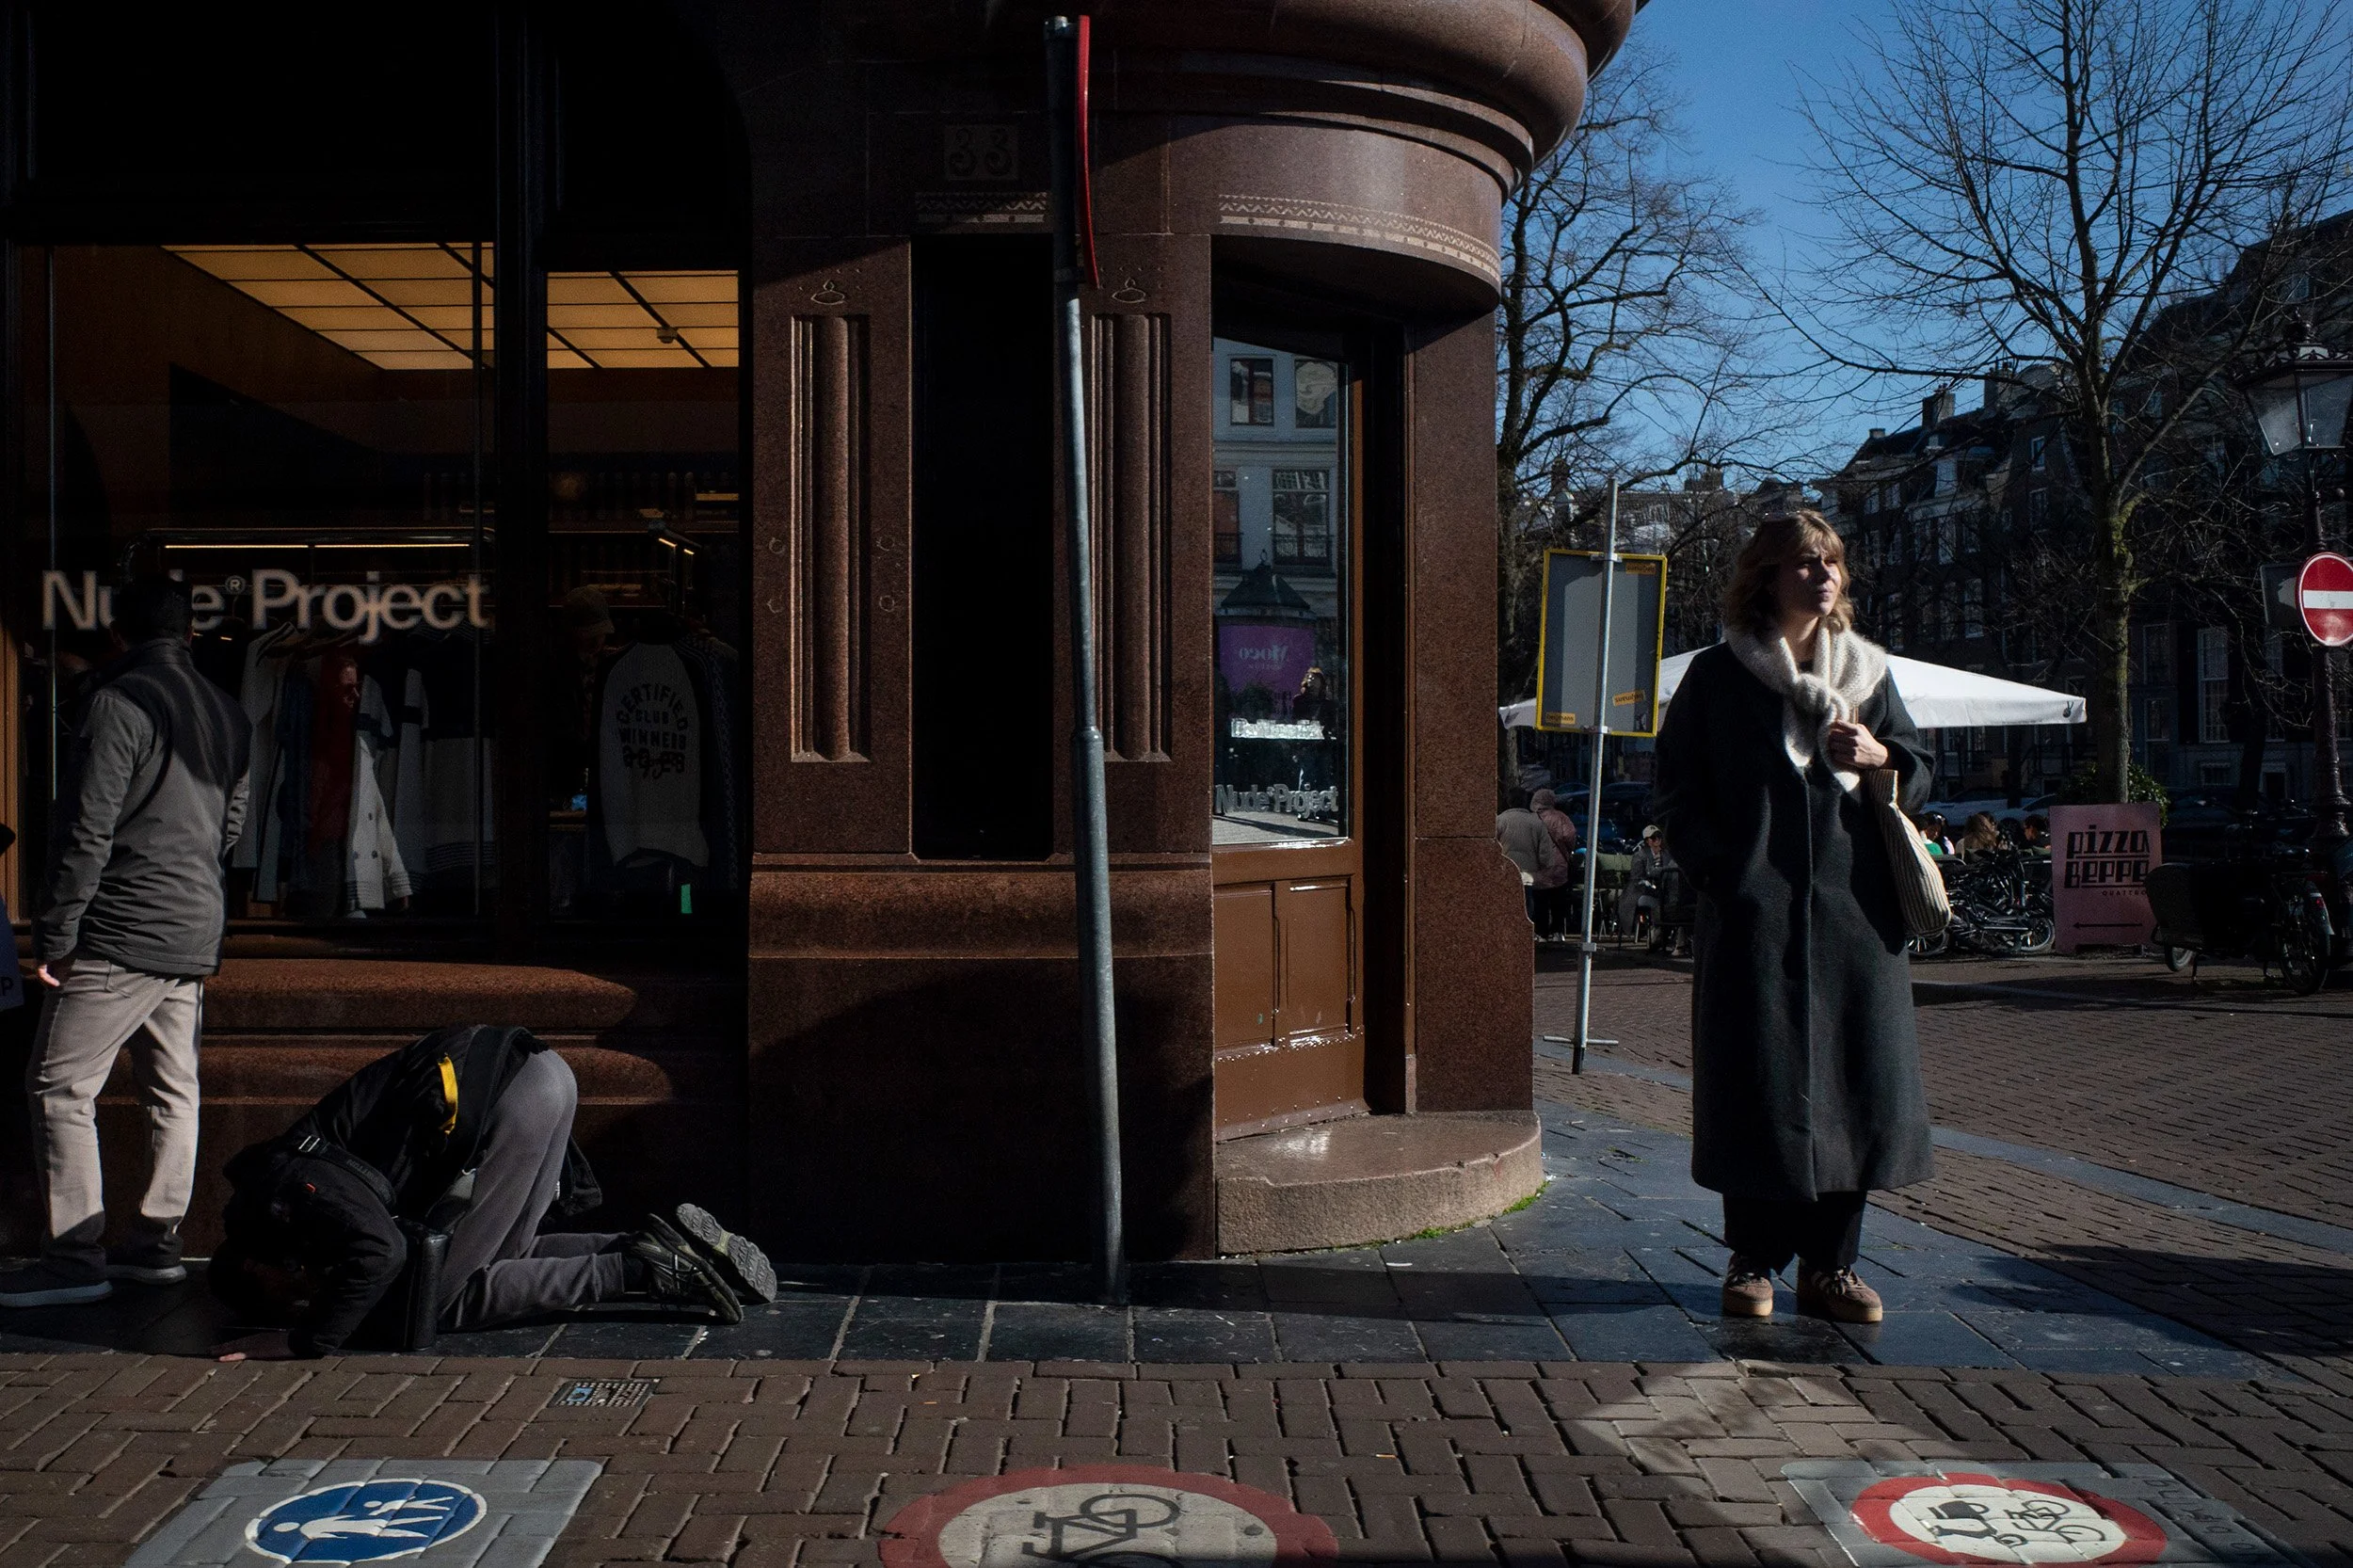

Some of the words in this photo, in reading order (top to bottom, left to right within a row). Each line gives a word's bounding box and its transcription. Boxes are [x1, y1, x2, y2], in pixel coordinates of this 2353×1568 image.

[949, 128, 1012, 177] 33
[42, 569, 225, 631] Ne
[252, 568, 490, 644] Project
[616, 684, 688, 731] CERTIFIED
[636, 710, 669, 725] CLUB
[619, 728, 686, 750] WINNERS
[1215, 784, 1271, 813] Nude
[1273, 783, 1338, 819] Project
